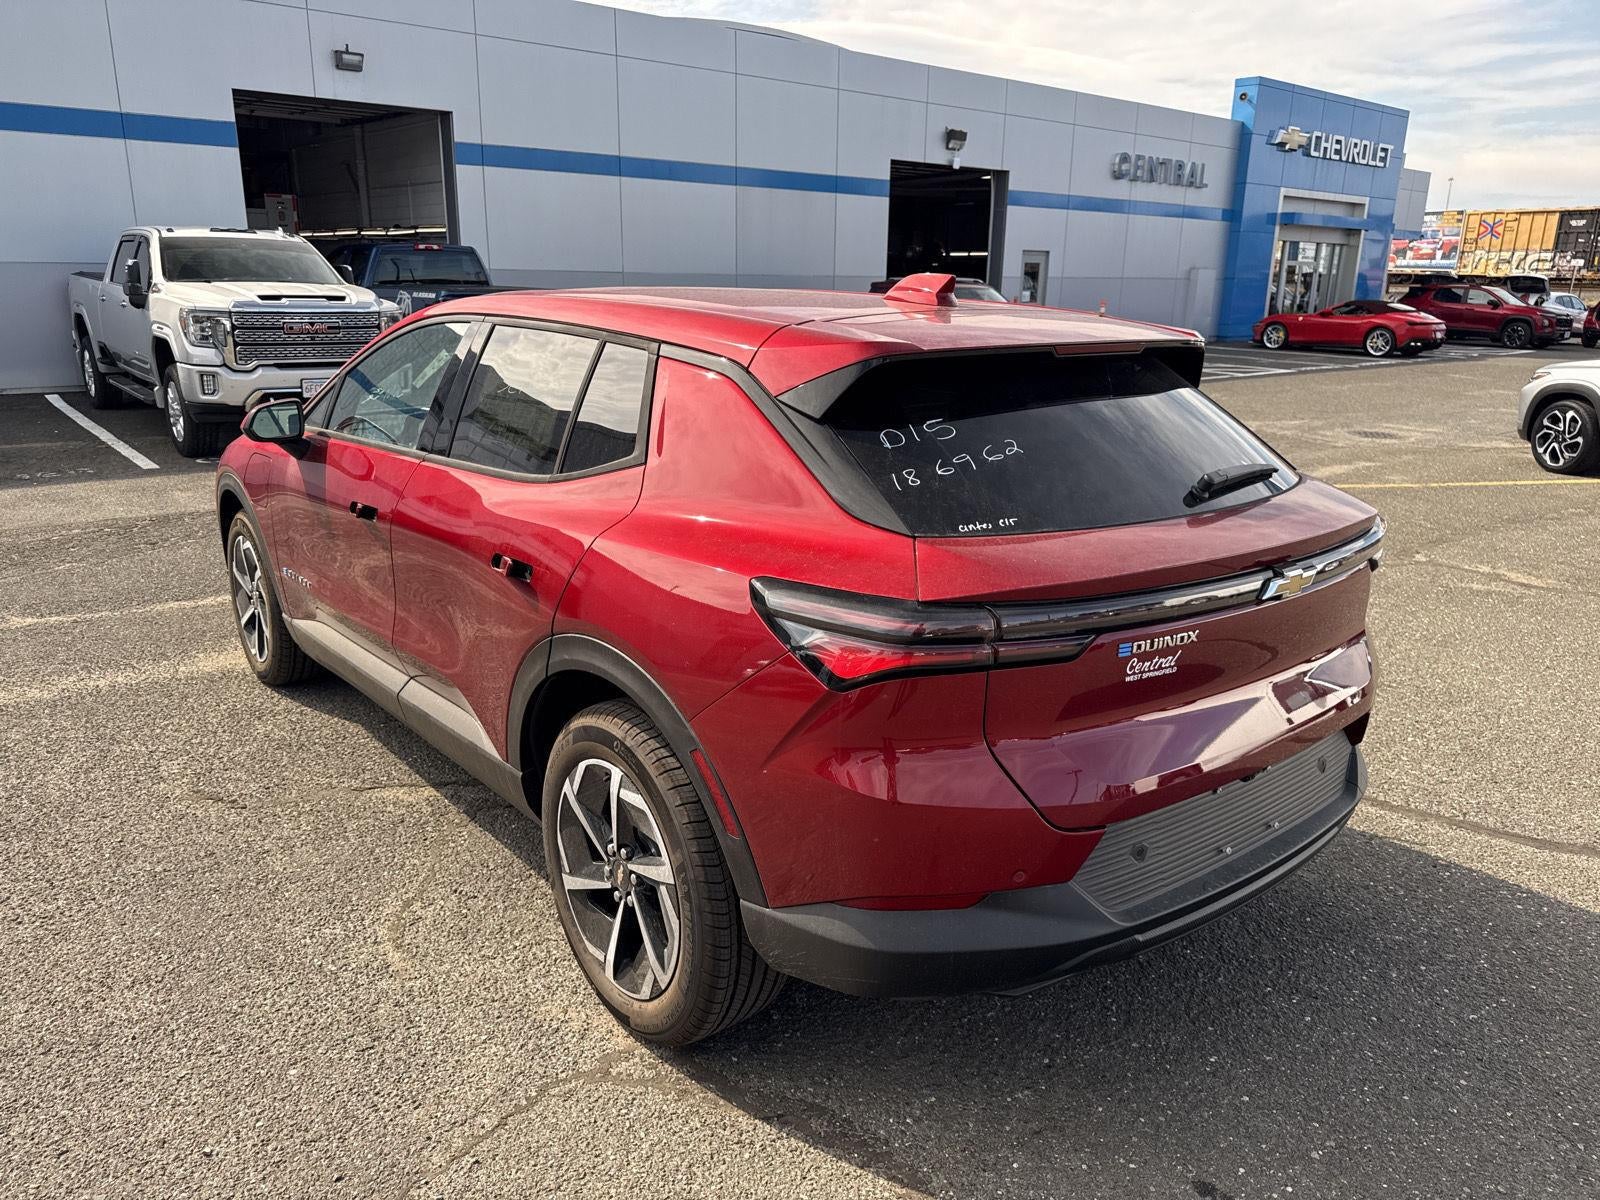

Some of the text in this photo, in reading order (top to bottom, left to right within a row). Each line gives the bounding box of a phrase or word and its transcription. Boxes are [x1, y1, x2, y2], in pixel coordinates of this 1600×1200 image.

[1310, 130, 1394, 168] CHEVROLET
[1111, 152, 1208, 188] CENTRAL
[283, 322, 340, 334] GMC
[1117, 629, 1200, 657] EQUINOX
[1125, 666, 1178, 682] WEST SPRINGFIELD
[1126, 649, 1182, 674] Central
